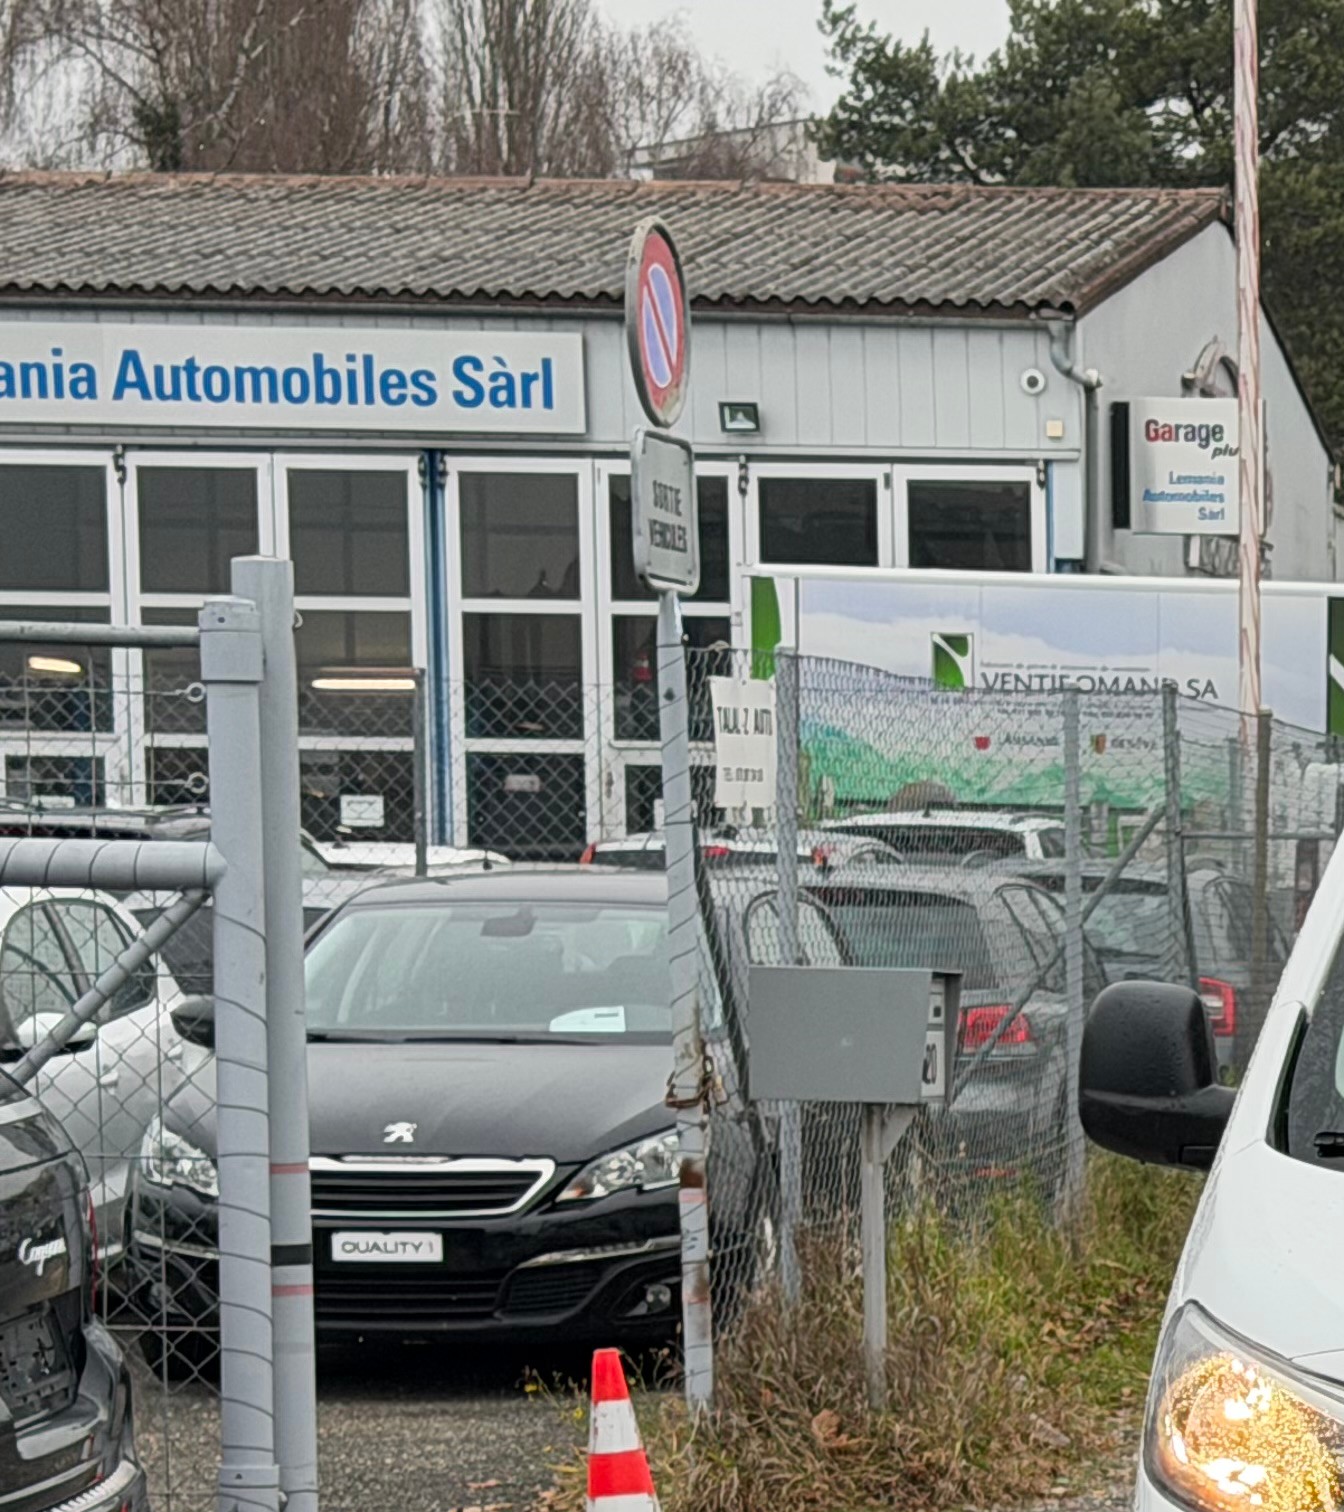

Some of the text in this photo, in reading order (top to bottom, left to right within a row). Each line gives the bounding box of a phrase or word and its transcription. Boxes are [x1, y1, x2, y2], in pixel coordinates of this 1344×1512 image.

[112, 349, 438, 407] Automobiles
[452, 355, 554, 409] Sàrl
[1144, 418, 1225, 449] Garage
[1186, 678, 1219, 700] SA
